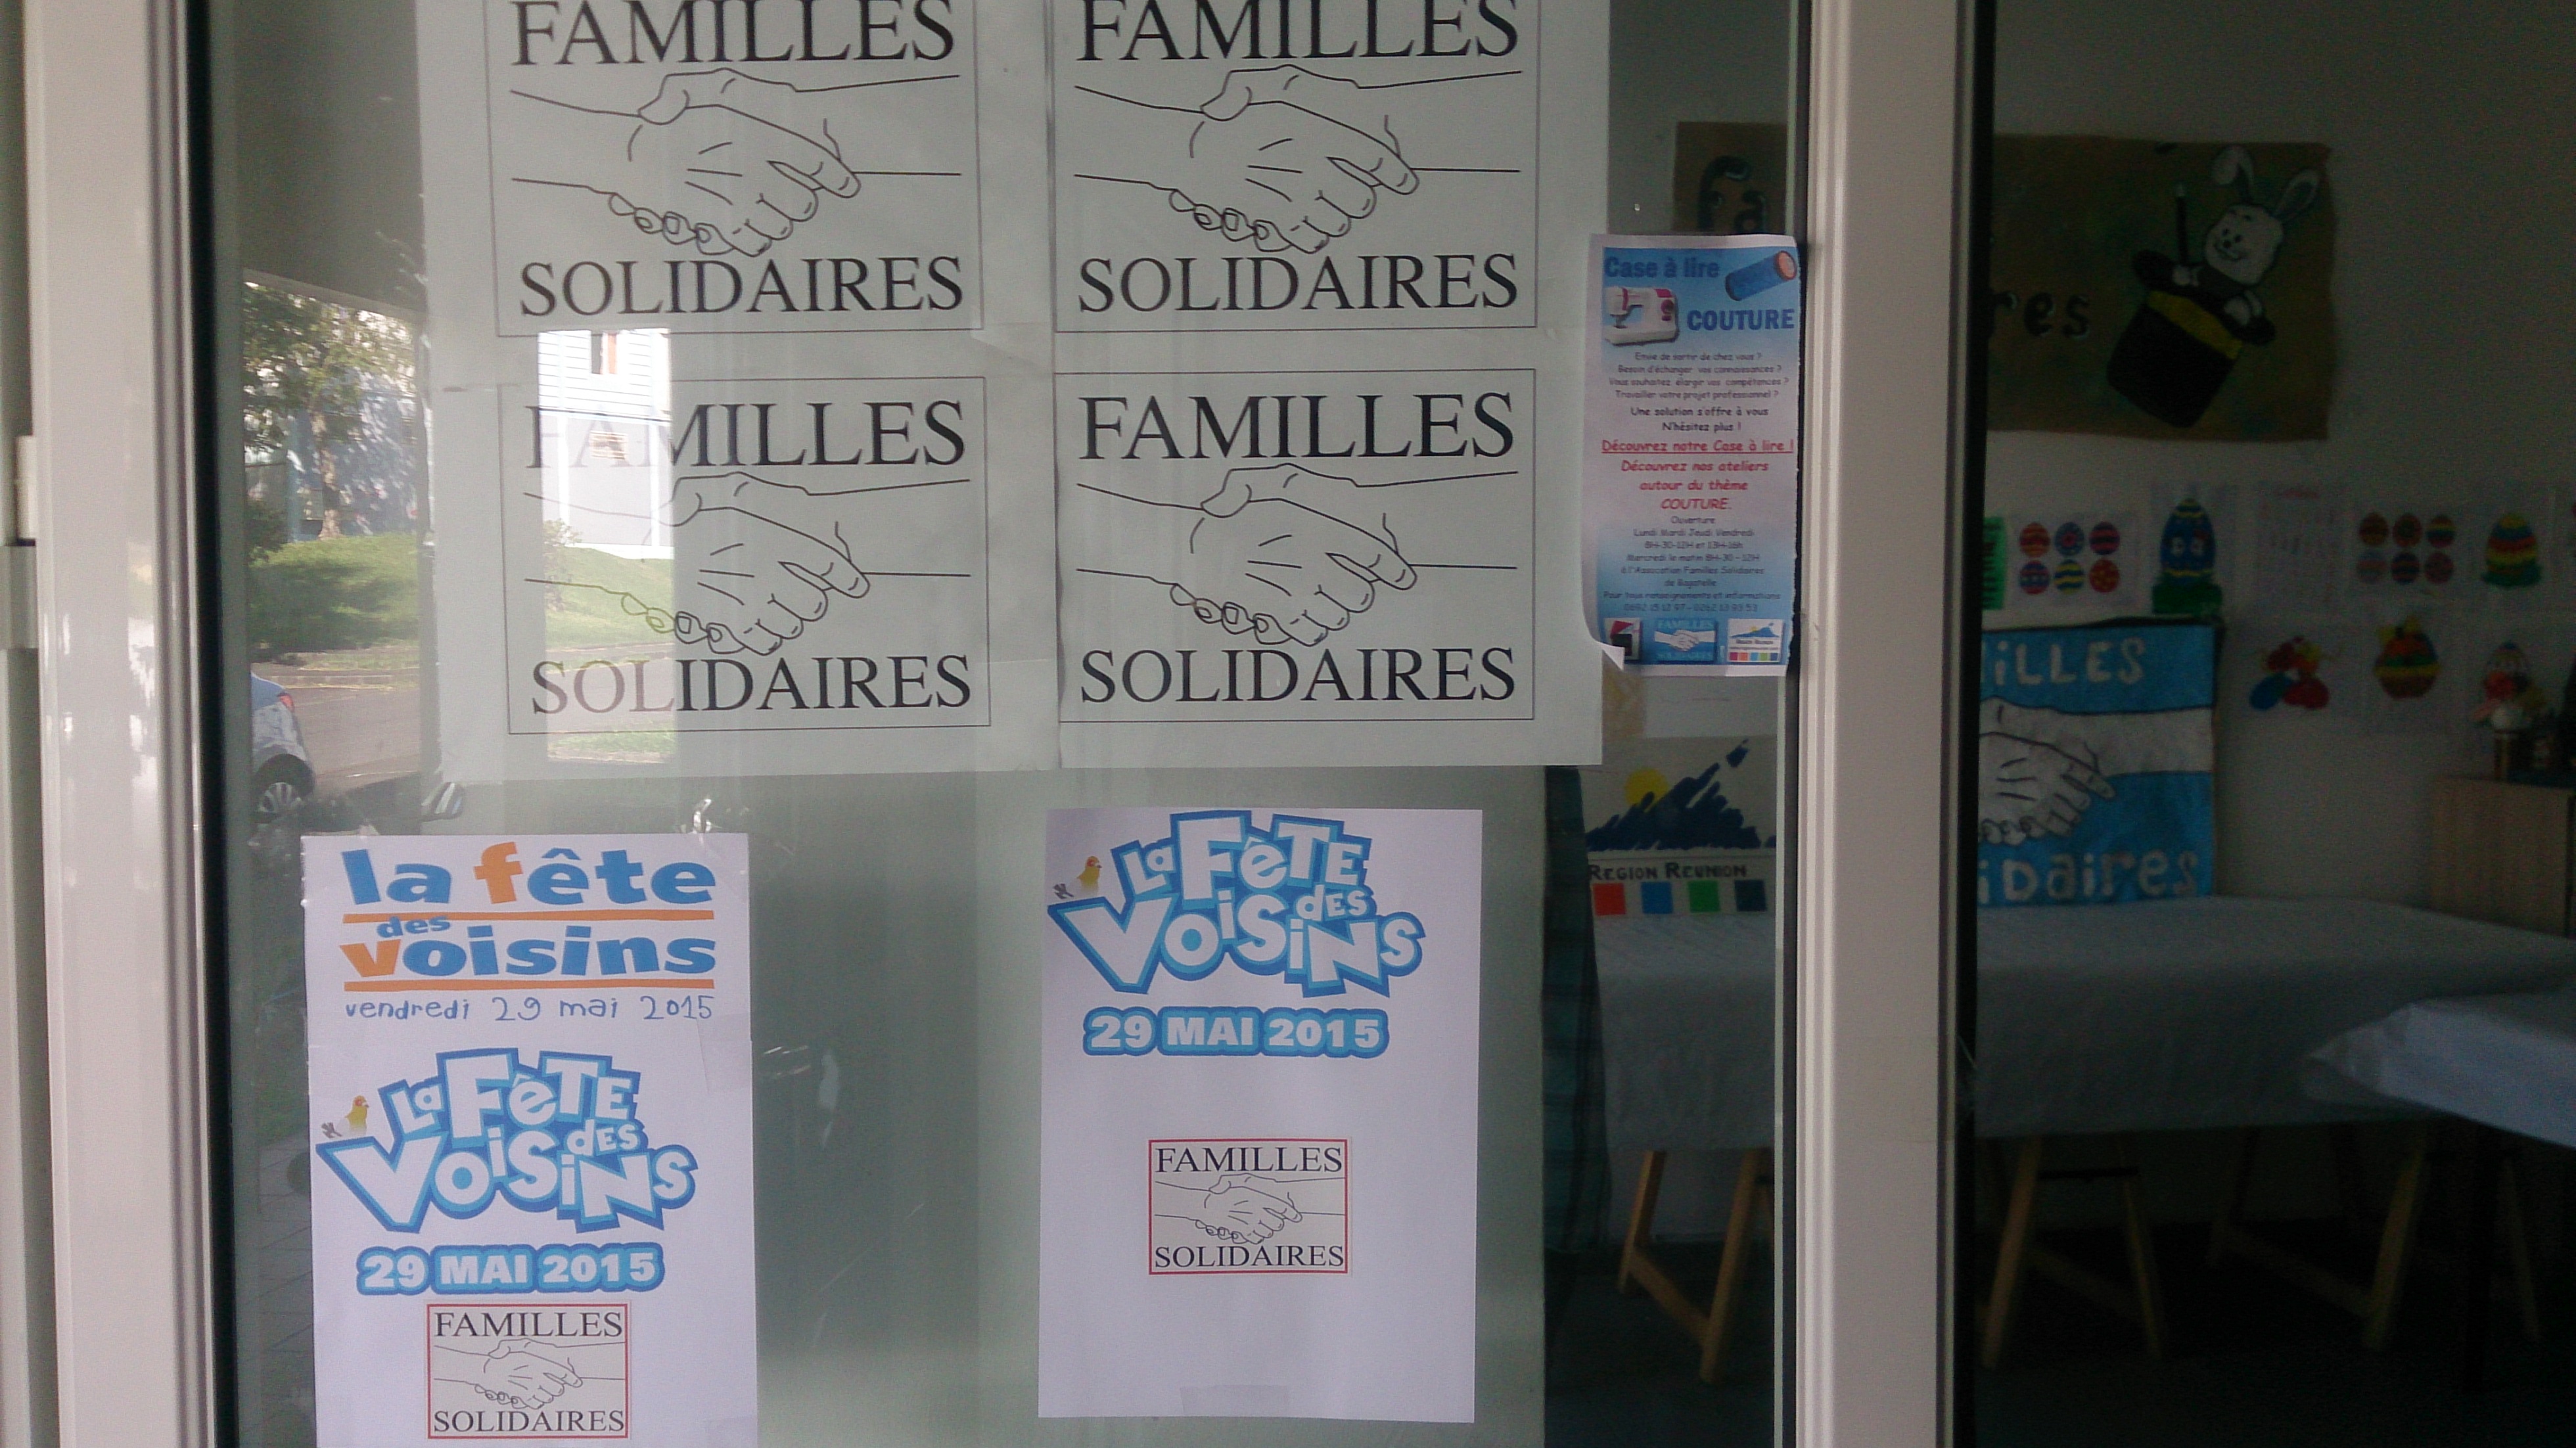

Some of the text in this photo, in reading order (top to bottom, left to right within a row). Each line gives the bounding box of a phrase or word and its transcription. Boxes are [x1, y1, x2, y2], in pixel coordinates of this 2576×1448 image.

[512, 0, 955, 64] FAMILLES
[1076, 0, 1518, 60] FAMILLES
[1079, 253, 1518, 312] SOLIDAIRES
[1605, 256, 1719, 278] Case à lire
[521, 256, 963, 317] SOLIDAIRES
[1687, 309, 1795, 330] COUTURE
[1078, 393, 1513, 459] FAMILLES
[1601, 439, 1668, 451] Découvrez
[1672, 440, 1708, 451] notre
[1713, 439, 1743, 451] Case
[1749, 439, 1757, 451] à
[1762, 440, 1785, 451] lire
[1621, 460, 1687, 472] Découvrez
[1718, 461, 1769, 472] ateliers
[1640, 480, 1748, 490] autour du thème
[532, 655, 971, 713] SOLIDAIRES
[1081, 647, 1514, 702] SOLIDAIRES
[341, 842, 716, 905] la fête
[377, 916, 451, 938] des
[340, 925, 716, 977] voisins
[345, 995, 714, 1021] vendredi 29 mai 2015
[1089, 1013, 1381, 1049] 29 MAI 2015
[1155, 1146, 1343, 1173] FAMILLES
[362, 1251, 657, 1289] 29 MAI 2015
[1155, 1244, 1345, 1269] SOLIDAIRES
[434, 1311, 623, 1337] FAMILLES
[434, 1410, 625, 1434] SOLIDAIRES
